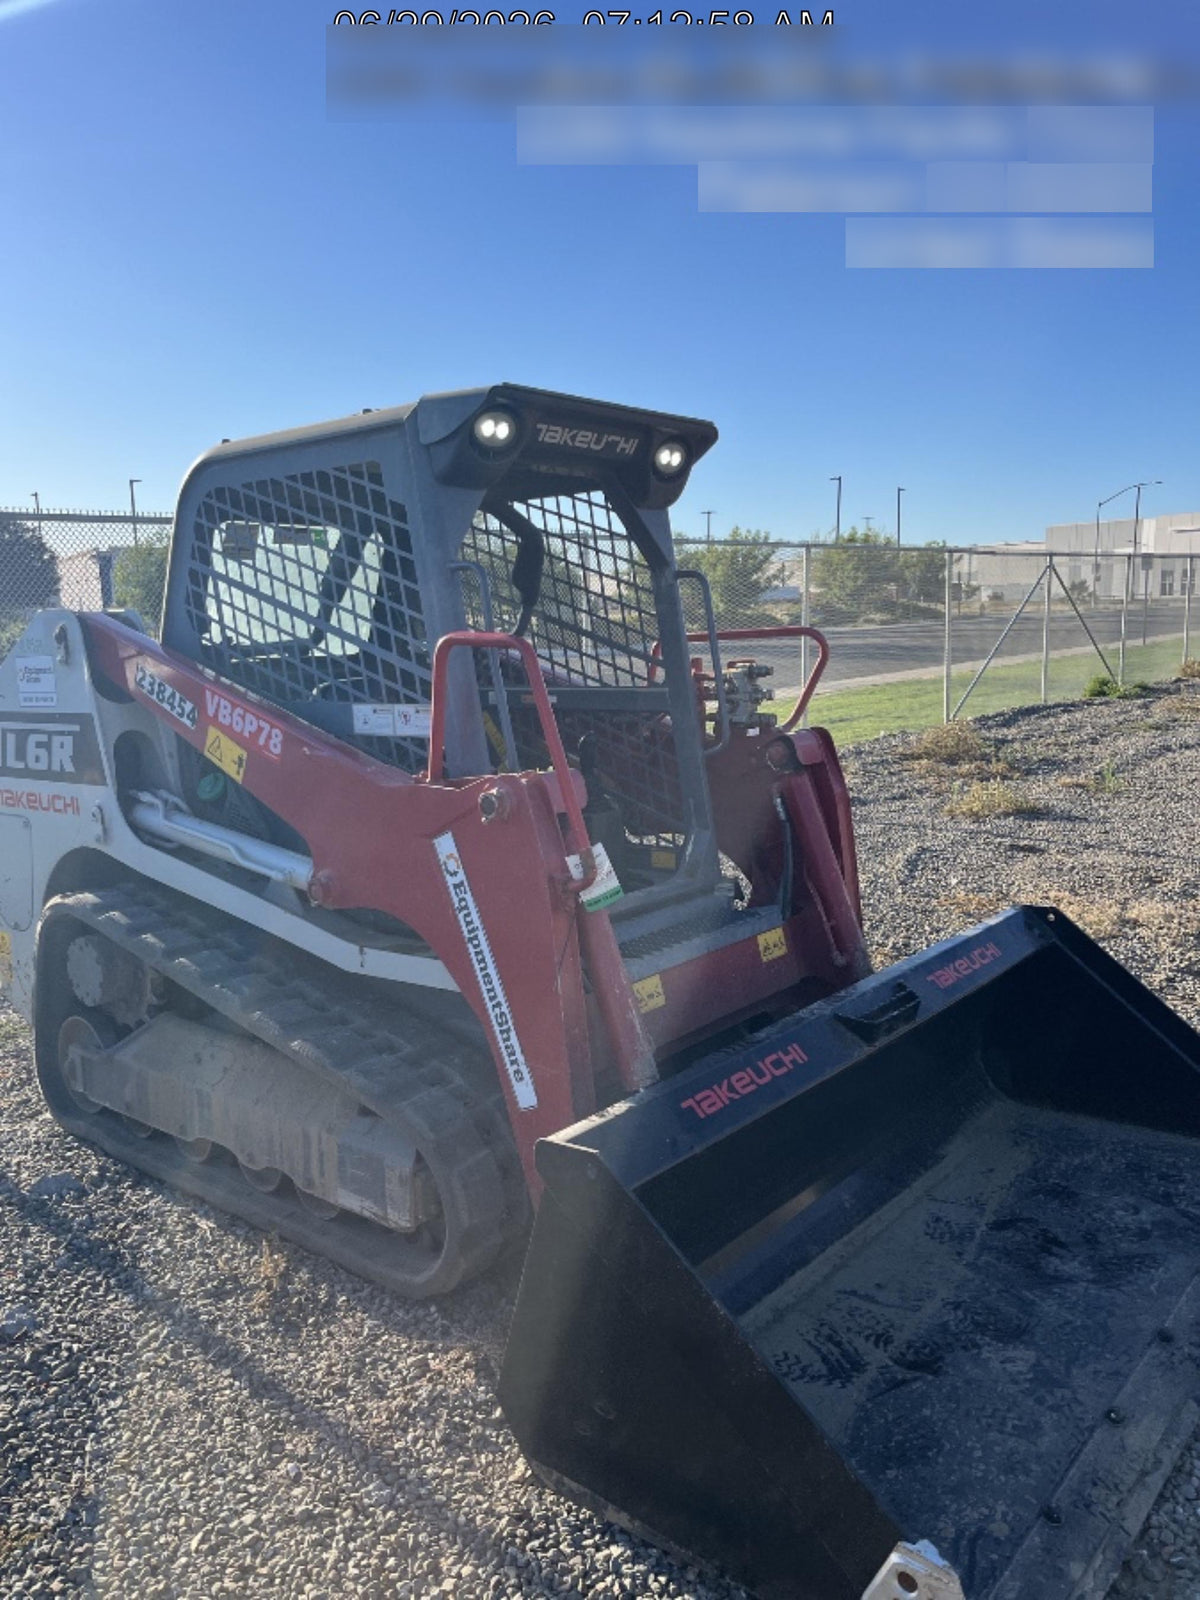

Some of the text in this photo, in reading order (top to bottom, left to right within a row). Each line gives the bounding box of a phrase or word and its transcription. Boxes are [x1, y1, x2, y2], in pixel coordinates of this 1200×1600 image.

[137, 665, 198, 728] 238454
[205, 688, 283, 755] VB6P78
[0, 732, 76, 772] L6R
[452, 879, 524, 1084] EquipmentShare
[926, 942, 1002, 989] TAKEUCHI
[681, 1042, 808, 1119] TAKEUCHI
